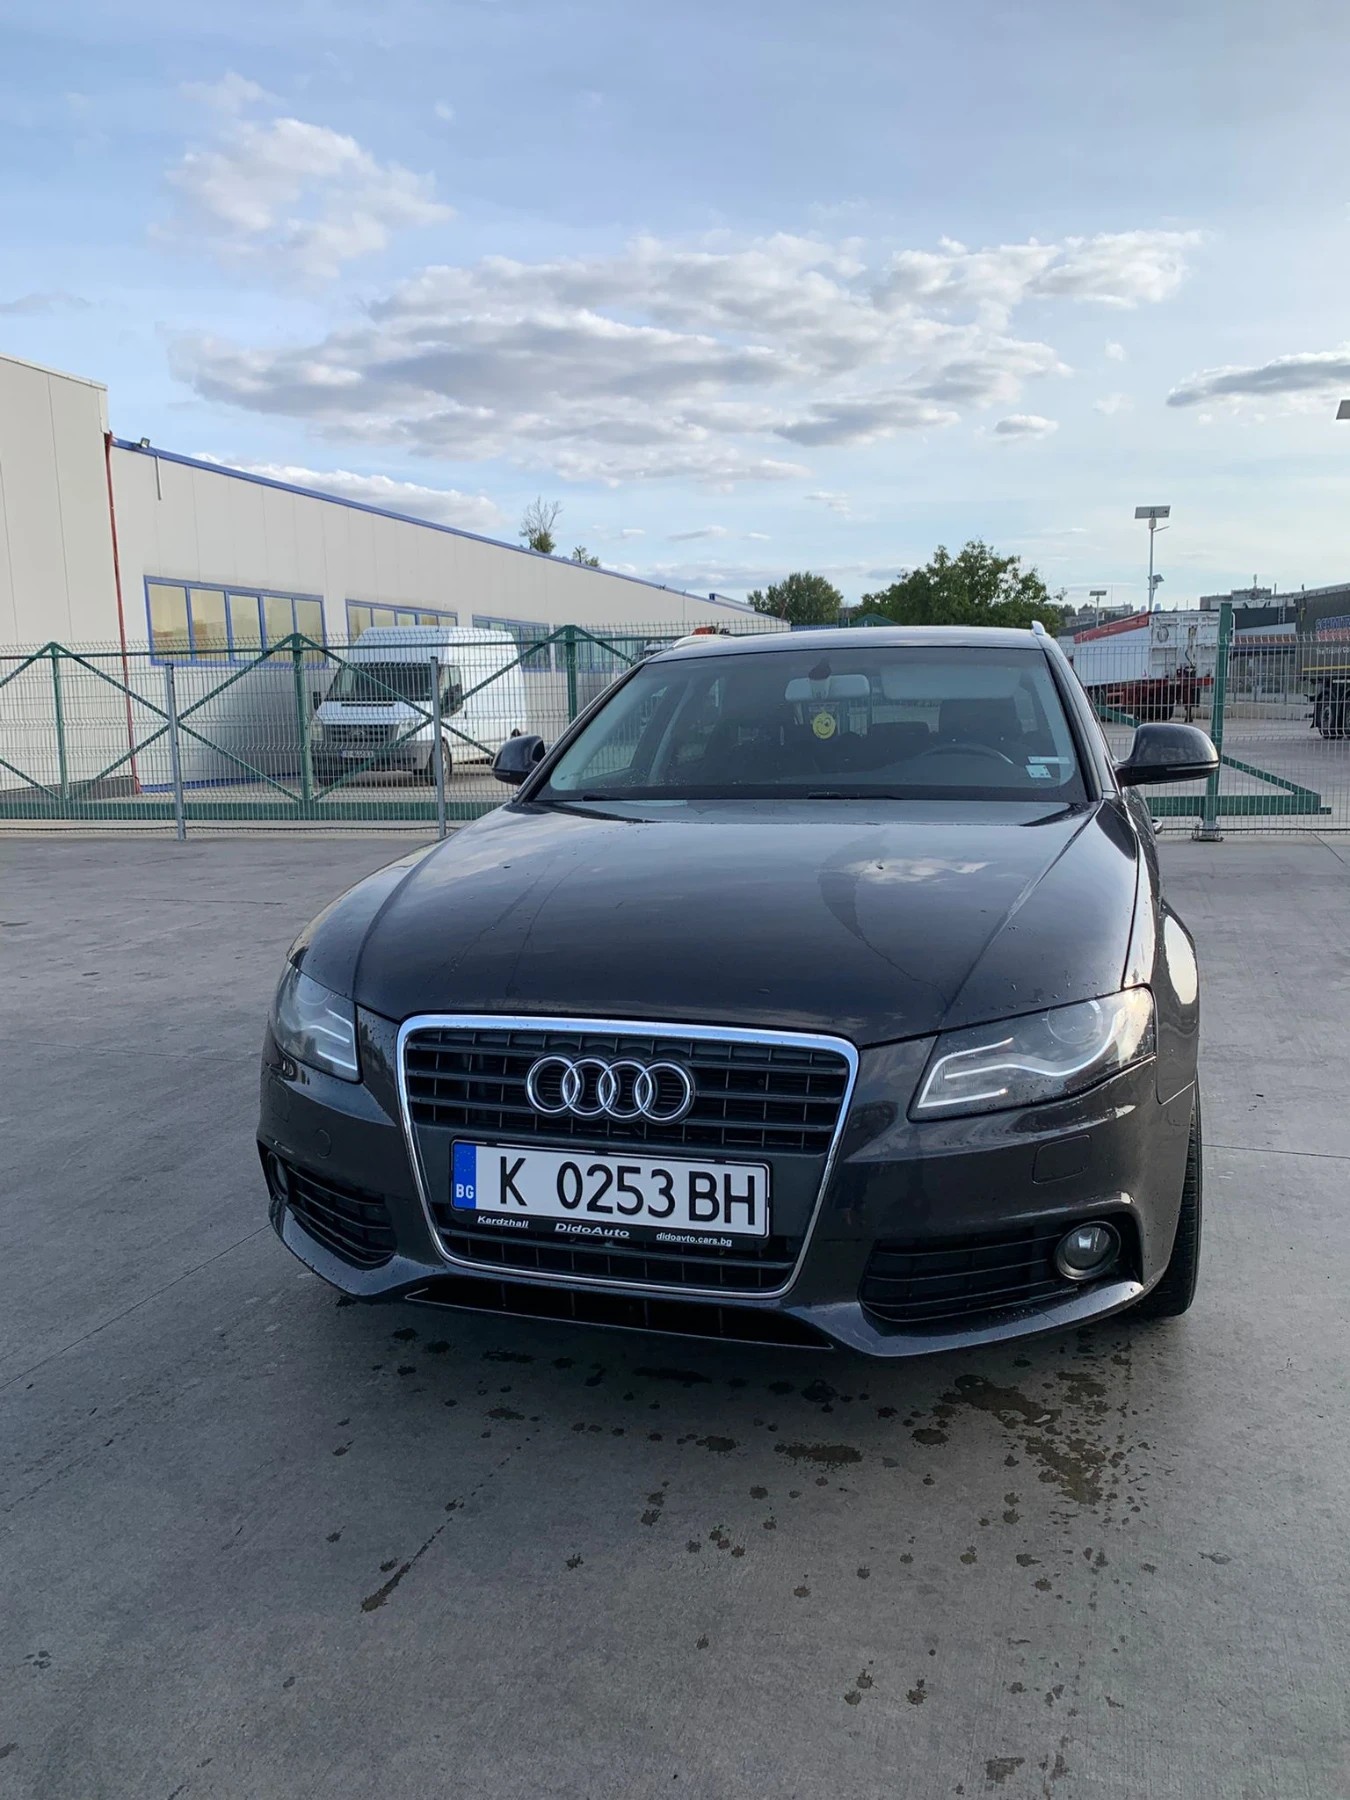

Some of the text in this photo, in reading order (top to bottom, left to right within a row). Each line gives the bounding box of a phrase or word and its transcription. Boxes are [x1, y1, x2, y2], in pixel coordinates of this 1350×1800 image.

[456, 1183, 475, 1199] BG
[500, 1156, 756, 1226] K 0253 BH
[554, 1222, 630, 1239] DidoAuto
[656, 1232, 732, 1247] didoavto.cars.bg
